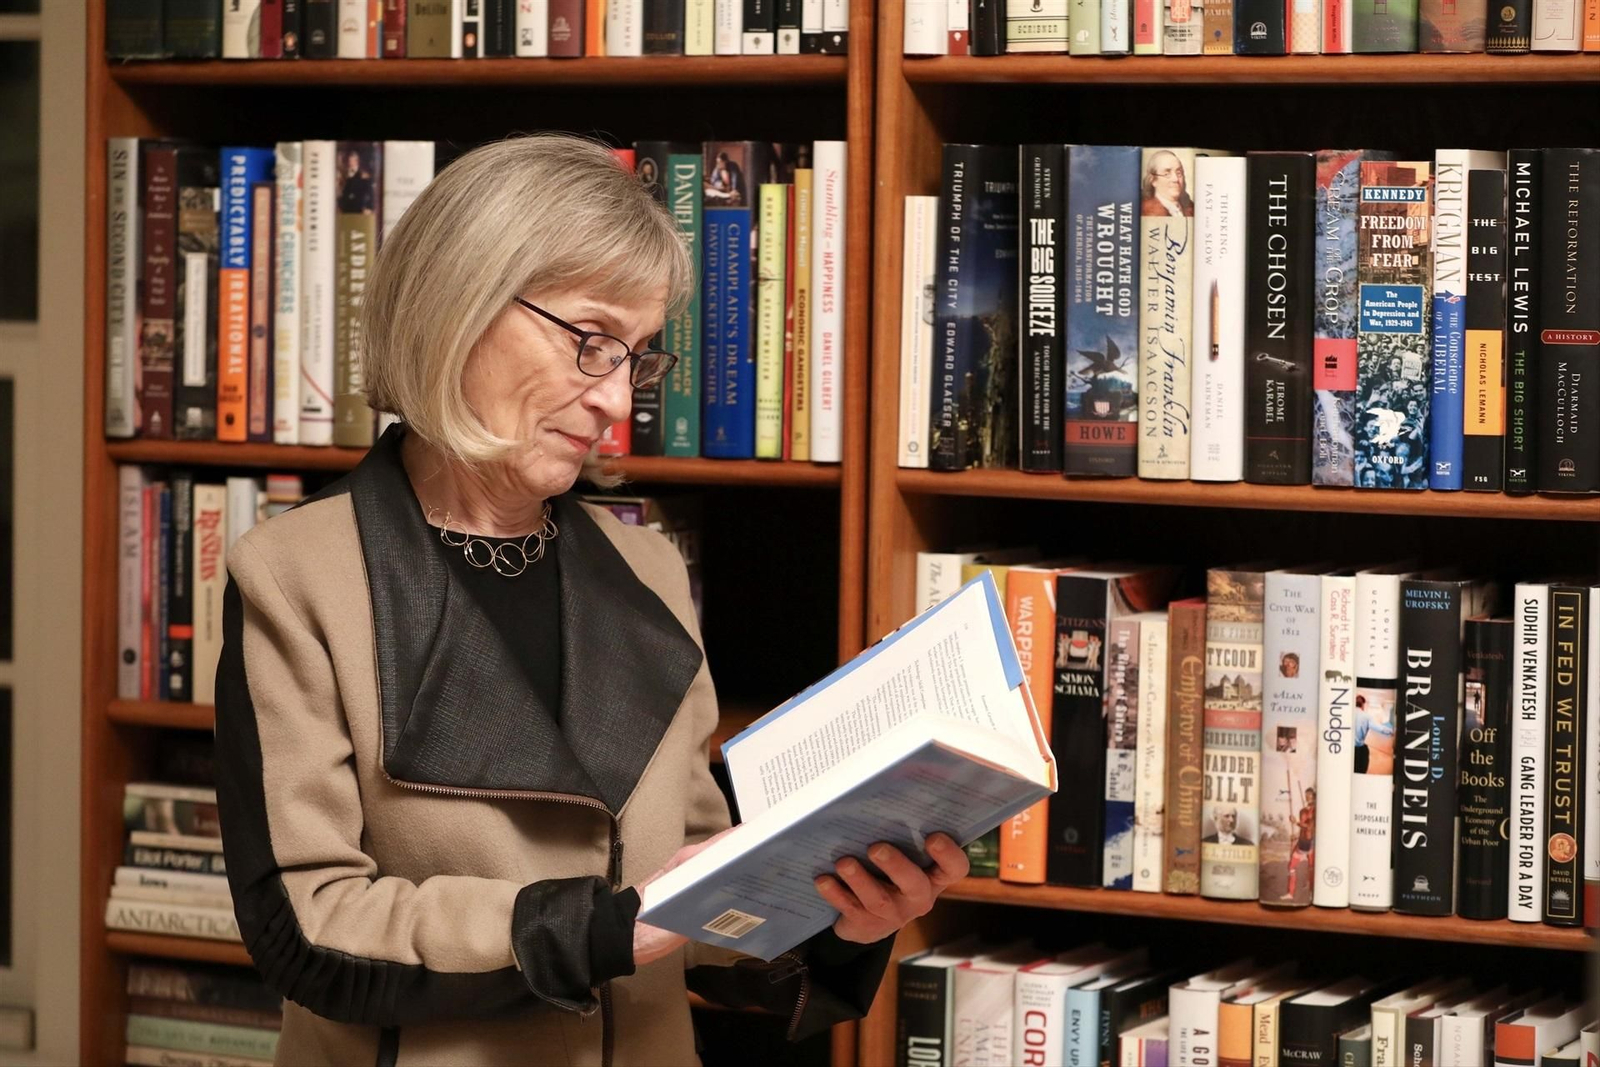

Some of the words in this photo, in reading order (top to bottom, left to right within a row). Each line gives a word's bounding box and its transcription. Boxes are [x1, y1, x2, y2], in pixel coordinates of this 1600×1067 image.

[112, 150, 128, 180] SIN
[1568, 162, 1580, 193] THE
[950, 162, 964, 220] TRIUMPH
[1033, 157, 1041, 210] GREENHOUSE
[1043, 168, 1051, 199] STEVEN
[1205, 183, 1213, 212] FAST
[1363, 187, 1424, 201] KENNEDY
[229, 155, 246, 266] PREDICTABLY
[278, 184, 294, 226] SUPER
[822, 169, 839, 239] Stumbling
[1267, 174, 1288, 227] THE
[1514, 162, 1531, 256] MICHAEL
[950, 226, 960, 242] OF
[1029, 218, 1055, 245] THE
[1119, 202, 1133, 242] WHAT
[1218, 193, 1229, 260] THINKING,
[1361, 216, 1427, 229] FREEDOM
[1437, 161, 1464, 283] KRUGMAN
[1473, 219, 1497, 227] THE
[111, 211, 126, 279] SECOND
[708, 223, 719, 267] DAVID
[1074, 226, 1083, 263] AMERICA,
[1204, 232, 1213, 266] SLOW
[1371, 234, 1414, 249] FROM
[1471, 246, 1498, 255] BIG
[1565, 199, 1579, 315] REFORMATION
[278, 232, 295, 314] CRUNCHERS
[948, 249, 960, 273] THE
[1031, 247, 1055, 273] BIG
[1085, 234, 1093, 303] TRANSFORMATION
[1095, 203, 1116, 316] WROUGHT
[1119, 246, 1132, 285] HATH
[1146, 227, 1160, 313] WALTER
[1372, 254, 1414, 268] FEAR
[726, 223, 740, 338] CHAMPLAIN'S
[822, 252, 834, 314] HAPPINESS
[1074, 264, 1082, 304] 1815-1848
[1153, 219, 1189, 334] Benjamin
[1267, 233, 1287, 340] CHOSEN
[1468, 273, 1501, 282] TEST
[707, 272, 719, 338] HACKETT
[947, 278, 959, 309] CITY
[1029, 275, 1056, 337] SQUEEZE
[1118, 287, 1131, 317] GOD
[1324, 266, 1343, 324] CROP
[1364, 300, 1396, 308] American
[1397, 301, 1418, 309] People
[1513, 268, 1529, 334] LEWIS
[227, 273, 245, 374] IRRATIONAL
[796, 289, 806, 346] ECONOMIC
[1370, 318, 1383, 327] War,
[1372, 310, 1406, 318] Depression
[1449, 312, 1458, 328] THE
[822, 332, 833, 366] DANIEL
[944, 322, 956, 370] EDWARD
[1557, 333, 1594, 341] HISTORY
[726, 344, 738, 405] DREAM
[1033, 350, 1041, 391] AMERICAN
[1042, 345, 1050, 371] TOUGH
[1433, 333, 1448, 394] LIBERAL
[1447, 331, 1461, 394] Conscience
[1478, 343, 1488, 386] NICHOLAS
[1514, 350, 1525, 376] THE
[682, 356, 692, 396] MACK
[706, 345, 718, 405] FISCHER
[796, 348, 805, 412] GANGSTERS
[821, 370, 832, 412] GILBERT
[1042, 373, 1050, 397] TIMES
[1145, 326, 1159, 439] ISAACSON
[1158, 338, 1190, 438] Franklin
[942, 374, 954, 428] GLAESER
[1032, 392, 1040, 425] WORKER
[1042, 399, 1050, 414] FOR
[1204, 373, 1212, 429] KAHNEMAN
[1216, 383, 1224, 420] DANIEL
[1265, 379, 1275, 425] KARABEL
[1275, 381, 1285, 422] JEROME
[1478, 388, 1487, 424] LEMANN
[1514, 381, 1525, 403] BIG
[1042, 416, 1050, 431] THE
[1079, 426, 1127, 440] HOWE
[1513, 407, 1524, 452] SHORT
[1371, 455, 1405, 465] OXFORD
[929, 562, 942, 586] The
[1269, 602, 1295, 613] CIVIL
[1298, 604, 1315, 614] WAR
[1284, 589, 1302, 599] THE
[1329, 590, 1340, 611] Cass
[1339, 588, 1351, 621] Richard
[1405, 590, 1441, 599] MELVIN
[1405, 600, 1452, 610] UROFSKY
[1282, 628, 1300, 636] 1812
[1523, 599, 1539, 645] SUDHIR
[1558, 605, 1574, 629] IN
[1117, 630, 1130, 648] The
[1328, 624, 1339, 660] Sunstein
[1338, 636, 1350, 663] Thaler
[1116, 653, 1130, 685] Rings
[1207, 648, 1257, 668] TYCOON
[1557, 641, 1574, 686] FED
[1054, 685, 1100, 698] SCHAMA
[1060, 673, 1096, 684] SIMON
[1521, 650, 1538, 721] VENKATESH
[1175, 655, 1204, 738] Emperor
[1270, 701, 1307, 714] TAYLOR
[1114, 704, 1127, 743] Saturn
[1324, 687, 1351, 755] Nudge
[1556, 698, 1573, 733] WE
[1205, 731, 1256, 747] CORNELIUS
[1401, 646, 1434, 850] BRANDEIS
[1431, 716, 1446, 761] Louis
[1470, 728, 1497, 743] Off
[1205, 754, 1254, 774] VANDER
[1470, 749, 1494, 765] the
[1520, 756, 1535, 790] GANG
[1204, 775, 1253, 804] BILT
[1430, 767, 1444, 784] D.
[1461, 770, 1505, 788] Books
[1554, 745, 1572, 825] TRUST
[1177, 764, 1202, 827] China
[1366, 802, 1378, 810] THE
[1460, 805, 1503, 815] Underground
[1473, 795, 1487, 803] The
[1354, 814, 1390, 823] DISPOSABLE
[1356, 828, 1387, 836] AMERICAN
[1465, 816, 1496, 825] Economy
[1478, 827, 1490, 835] the
[1519, 795, 1535, 840] LEADER
[1461, 837, 1481, 846] Urban
[1482, 838, 1499, 847] Poor
[1518, 845, 1533, 868] FOR
[1518, 872, 1533, 881] A
[1517, 885, 1532, 909] DAY
[116, 907, 239, 936] ANTARCTICA
[1071, 1009, 1081, 1045] ENVY
[1101, 1010, 1111, 1047] FLYNN
[1259, 1013, 1272, 1044] Mead
[1282, 1048, 1322, 1060] McCRAW
